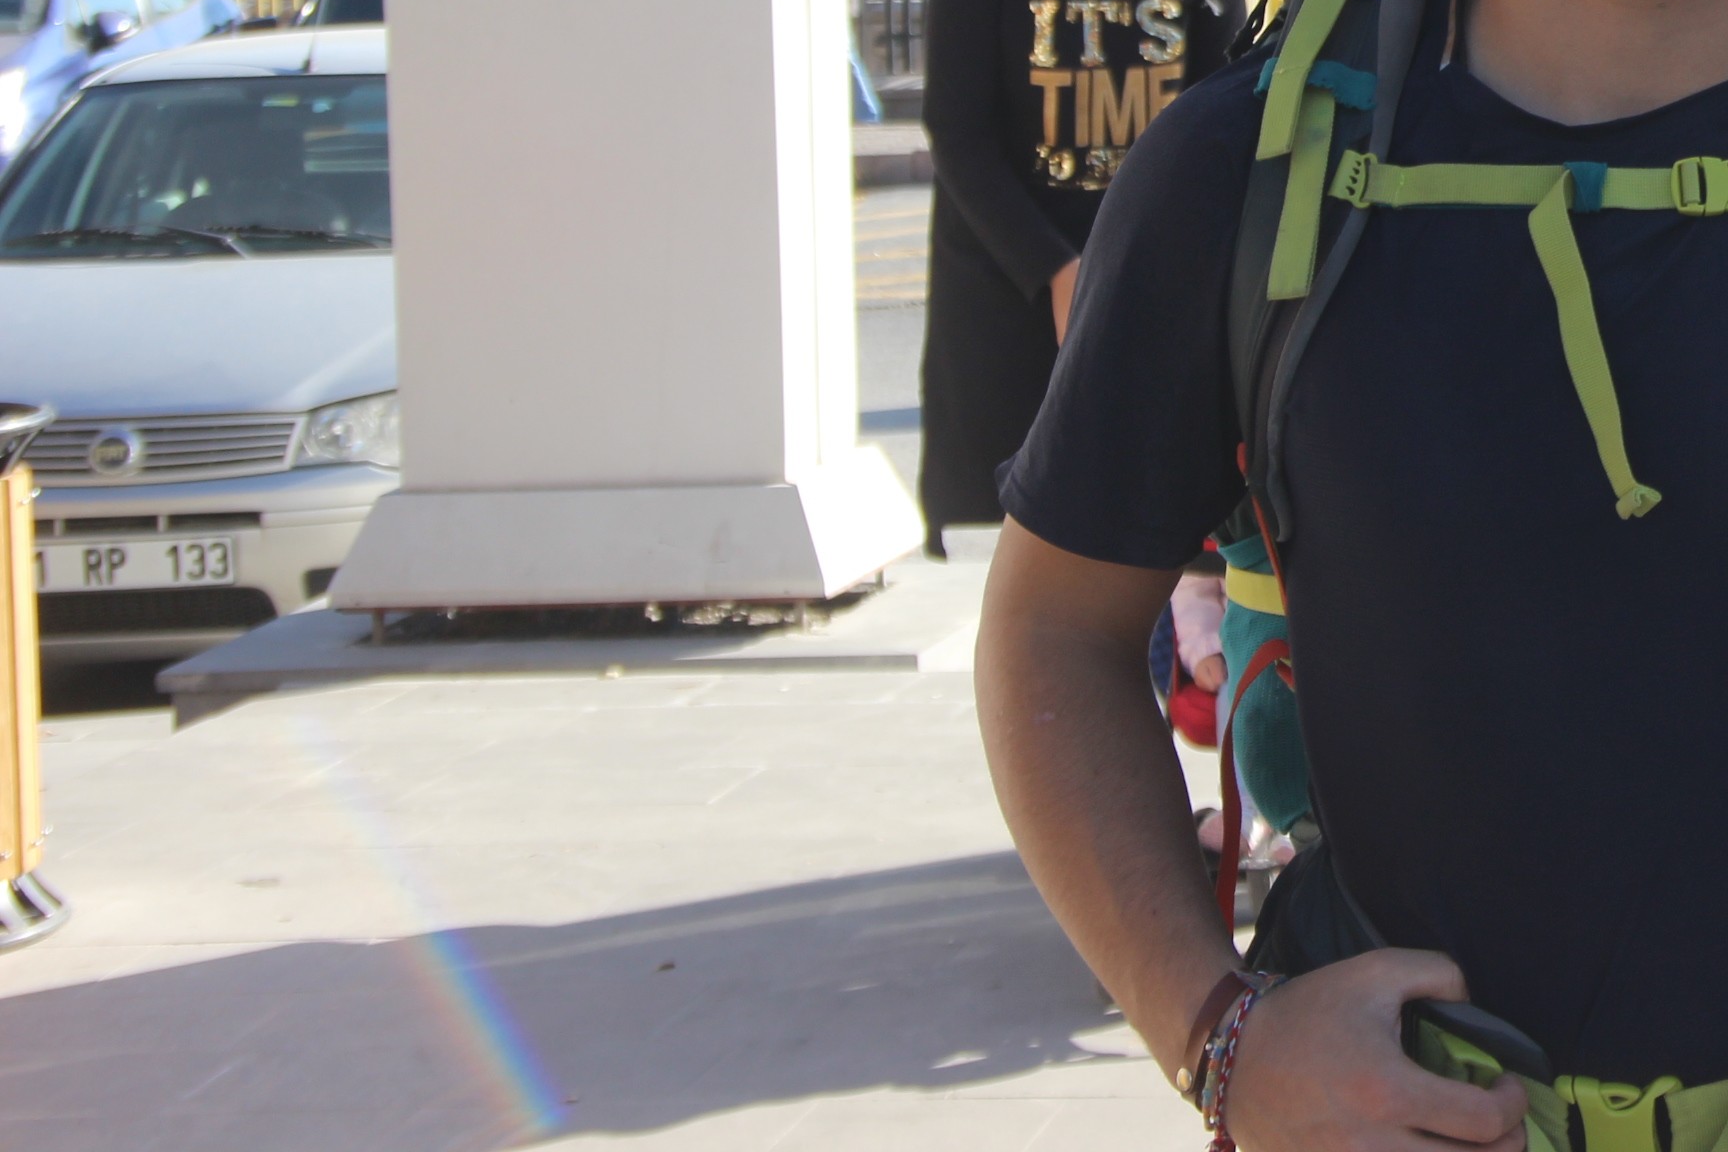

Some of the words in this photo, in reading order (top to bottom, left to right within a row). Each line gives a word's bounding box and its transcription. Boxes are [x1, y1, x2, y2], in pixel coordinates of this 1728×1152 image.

[33, 550, 46, 588] 1
[81, 546, 126, 587] RP
[166, 542, 229, 583] 133
